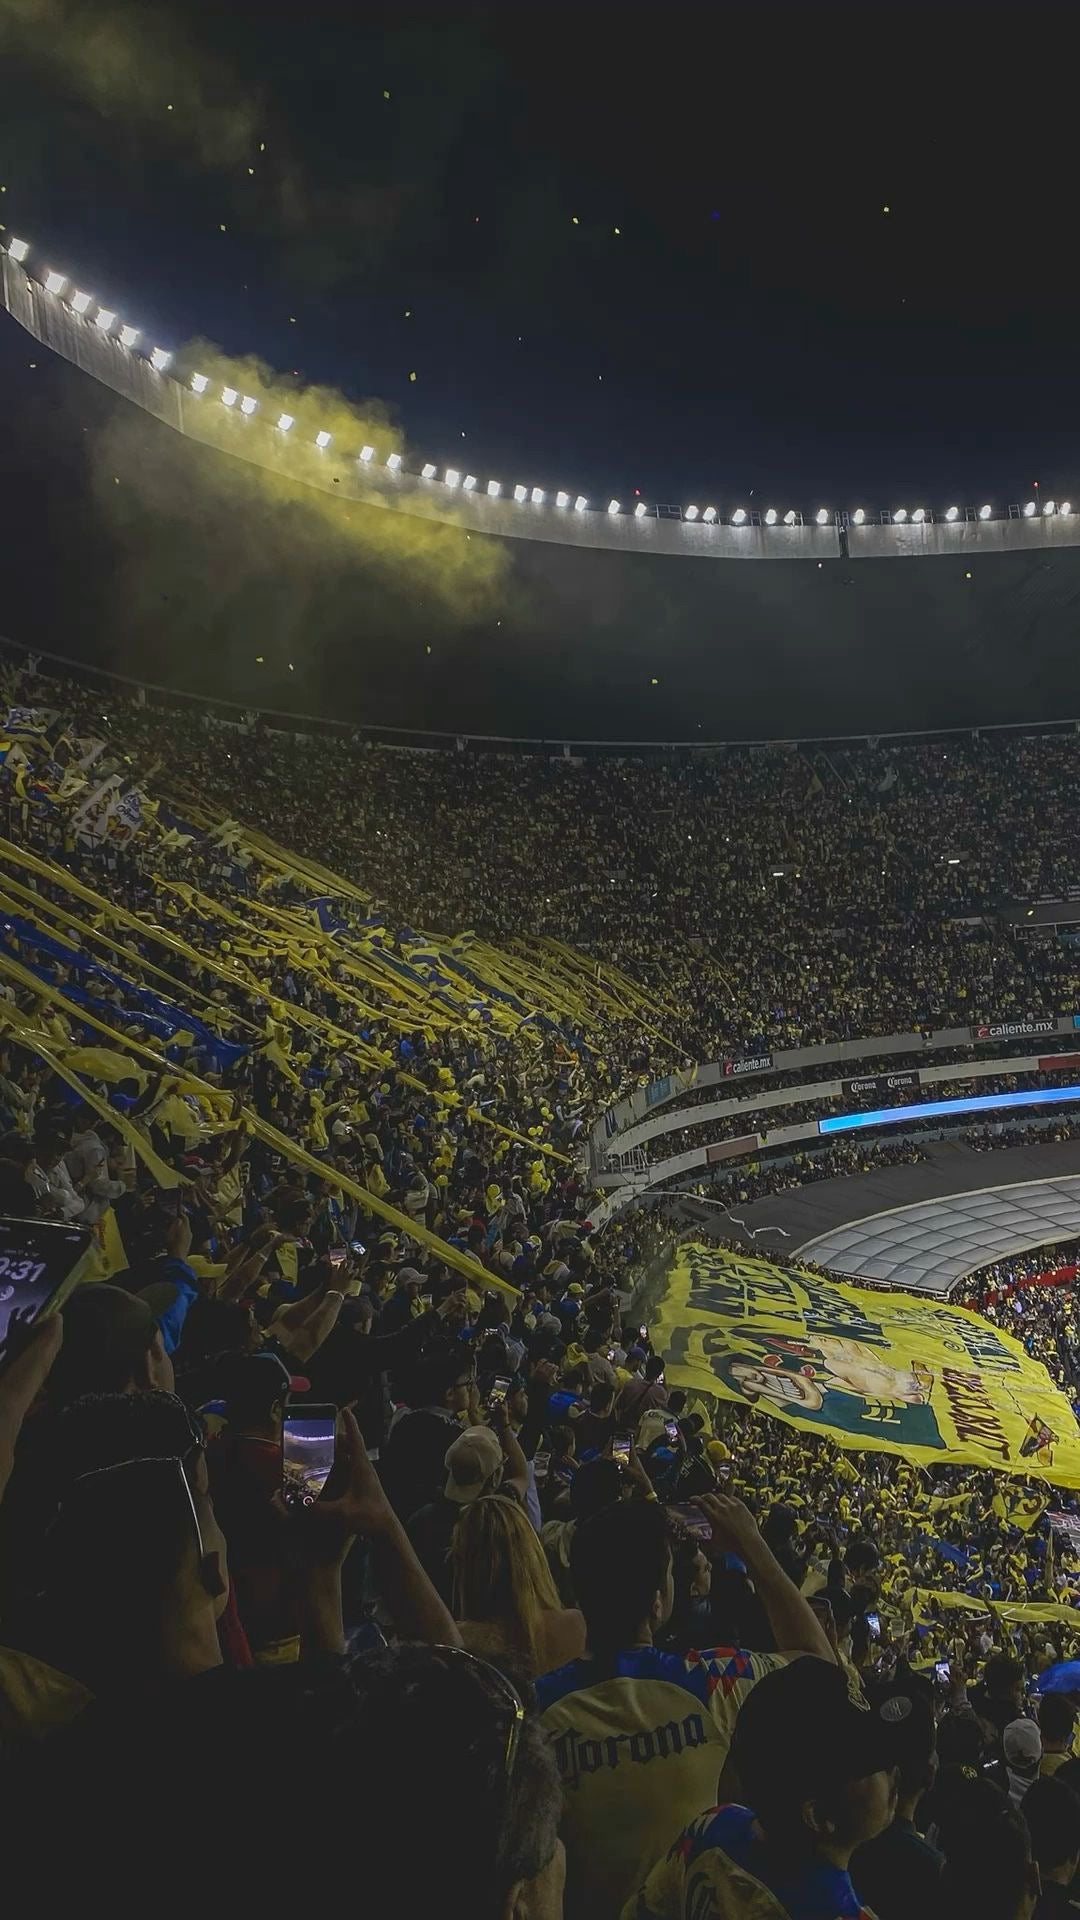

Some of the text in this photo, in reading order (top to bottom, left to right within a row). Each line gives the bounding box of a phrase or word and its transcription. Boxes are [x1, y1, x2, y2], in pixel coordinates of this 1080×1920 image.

[989, 1021, 1054, 1037] caliente.mx
[733, 1057, 770, 1073] caliente.mx
[850, 1076, 913, 1094] Corona Corona
[547, 1714, 708, 1786] Corona
